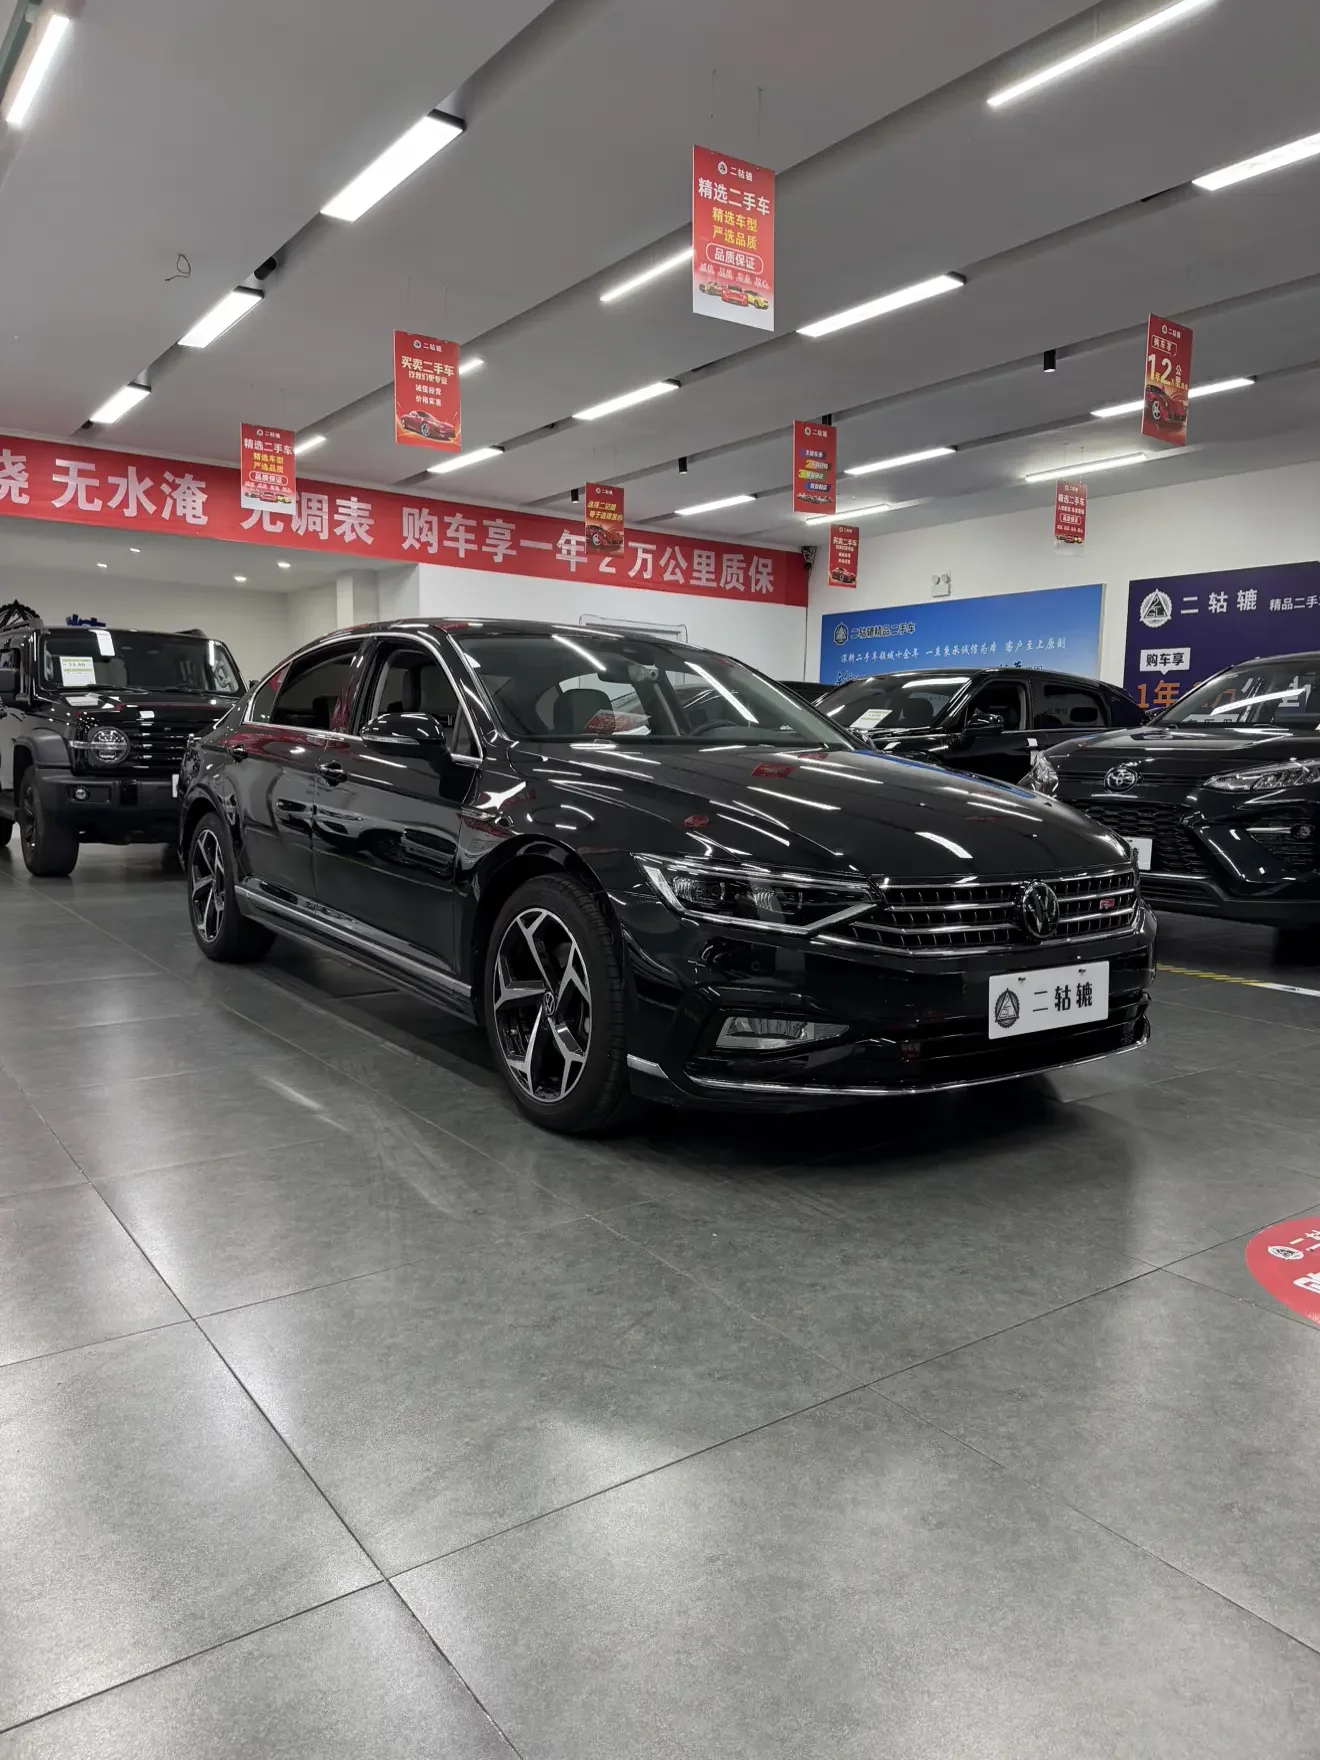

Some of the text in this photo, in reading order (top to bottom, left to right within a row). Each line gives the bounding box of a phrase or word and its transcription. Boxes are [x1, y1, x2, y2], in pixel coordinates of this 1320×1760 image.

[698, 177, 770, 216] 精选二手车
[712, 207, 758, 233] 精选车型
[712, 225, 757, 250] 严选品质
[714, 247, 756, 271] 品质保证
[401, 355, 455, 377] 买卖二手车
[244, 438, 293, 456] 精选二手车
[51, 458, 209, 525] 无水淹
[1181, 588, 1320, 614] 二轱辘 精品二手
[851, 622, 916, 639] 二轱辘精品二手车
[1005, 636, 1066, 653] 客户至上原则
[1146, 652, 1185, 667] 购车享
[1033, 981, 1093, 1012] 二轱辘
